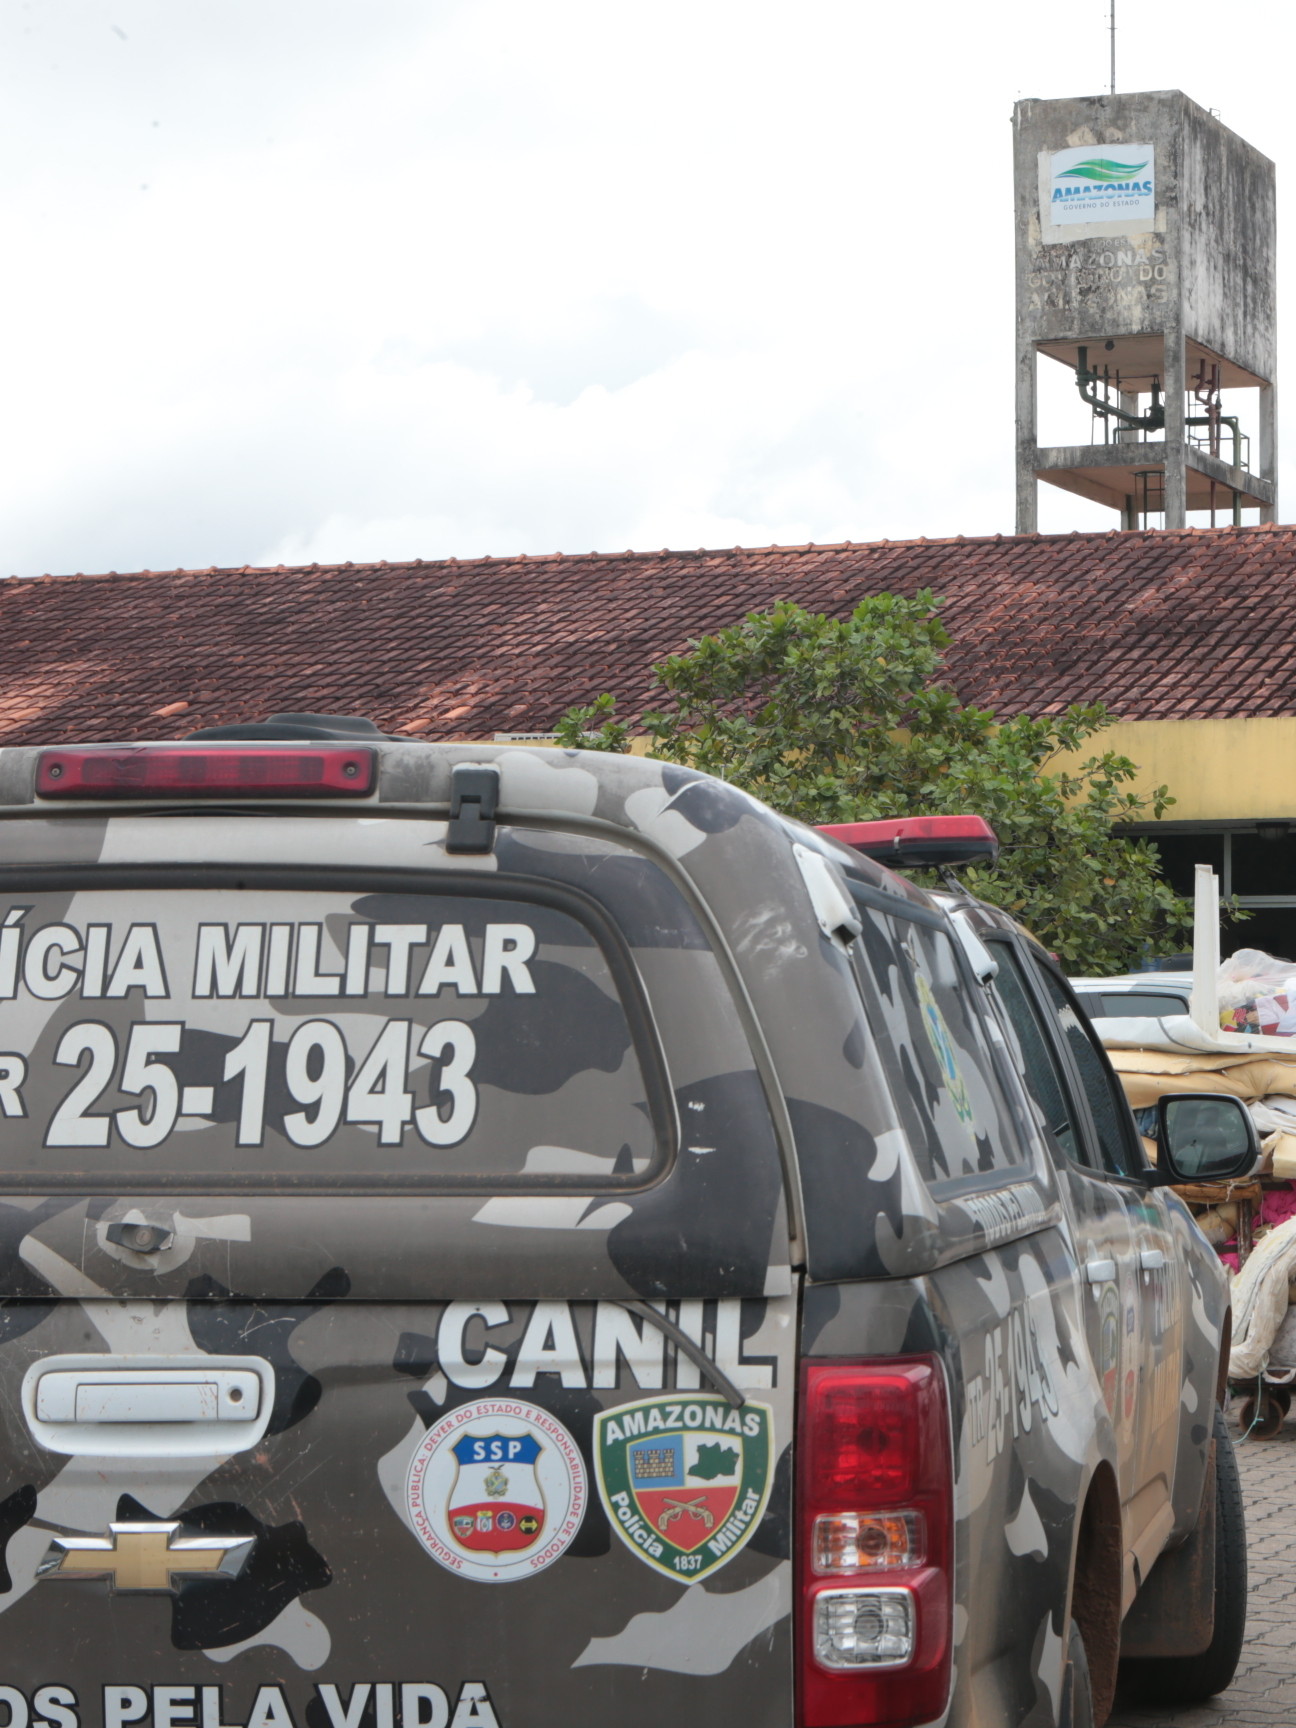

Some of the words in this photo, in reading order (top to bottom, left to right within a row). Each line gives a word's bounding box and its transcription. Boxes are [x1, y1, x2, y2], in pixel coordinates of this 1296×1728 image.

[1051, 180, 1153, 203] AMAZONAS
[1063, 202, 1098, 211] GOVERNO
[1113, 199, 1140, 207] ESTADO
[191, 922, 540, 999] MILITAR
[42, 1018, 480, 1150] 25-1943
[436, 1298, 777, 1390] CANIL
[455, 1409, 473, 1424] DO
[476, 1403, 522, 1416] ESTADO
[525, 1408, 532, 1418] E
[605, 1404, 761, 1447] AMAZONAS
[424, 1420, 454, 1452] DEVER
[473, 1440, 522, 1461] SSP
[534, 1413, 583, 1519] RESPONSABILIDADE
[562, 1520, 576, 1537] DE
[610, 1490, 664, 1558] Polícia
[707, 1487, 760, 1557] Militar
[415, 1510, 463, 1570] SEGURANÇA
[530, 1537, 567, 1569] TODOS
[673, 1554, 703, 1571] 1837
[102, 1683, 296, 1728] PELA
[313, 1681, 500, 1728] VIDA
